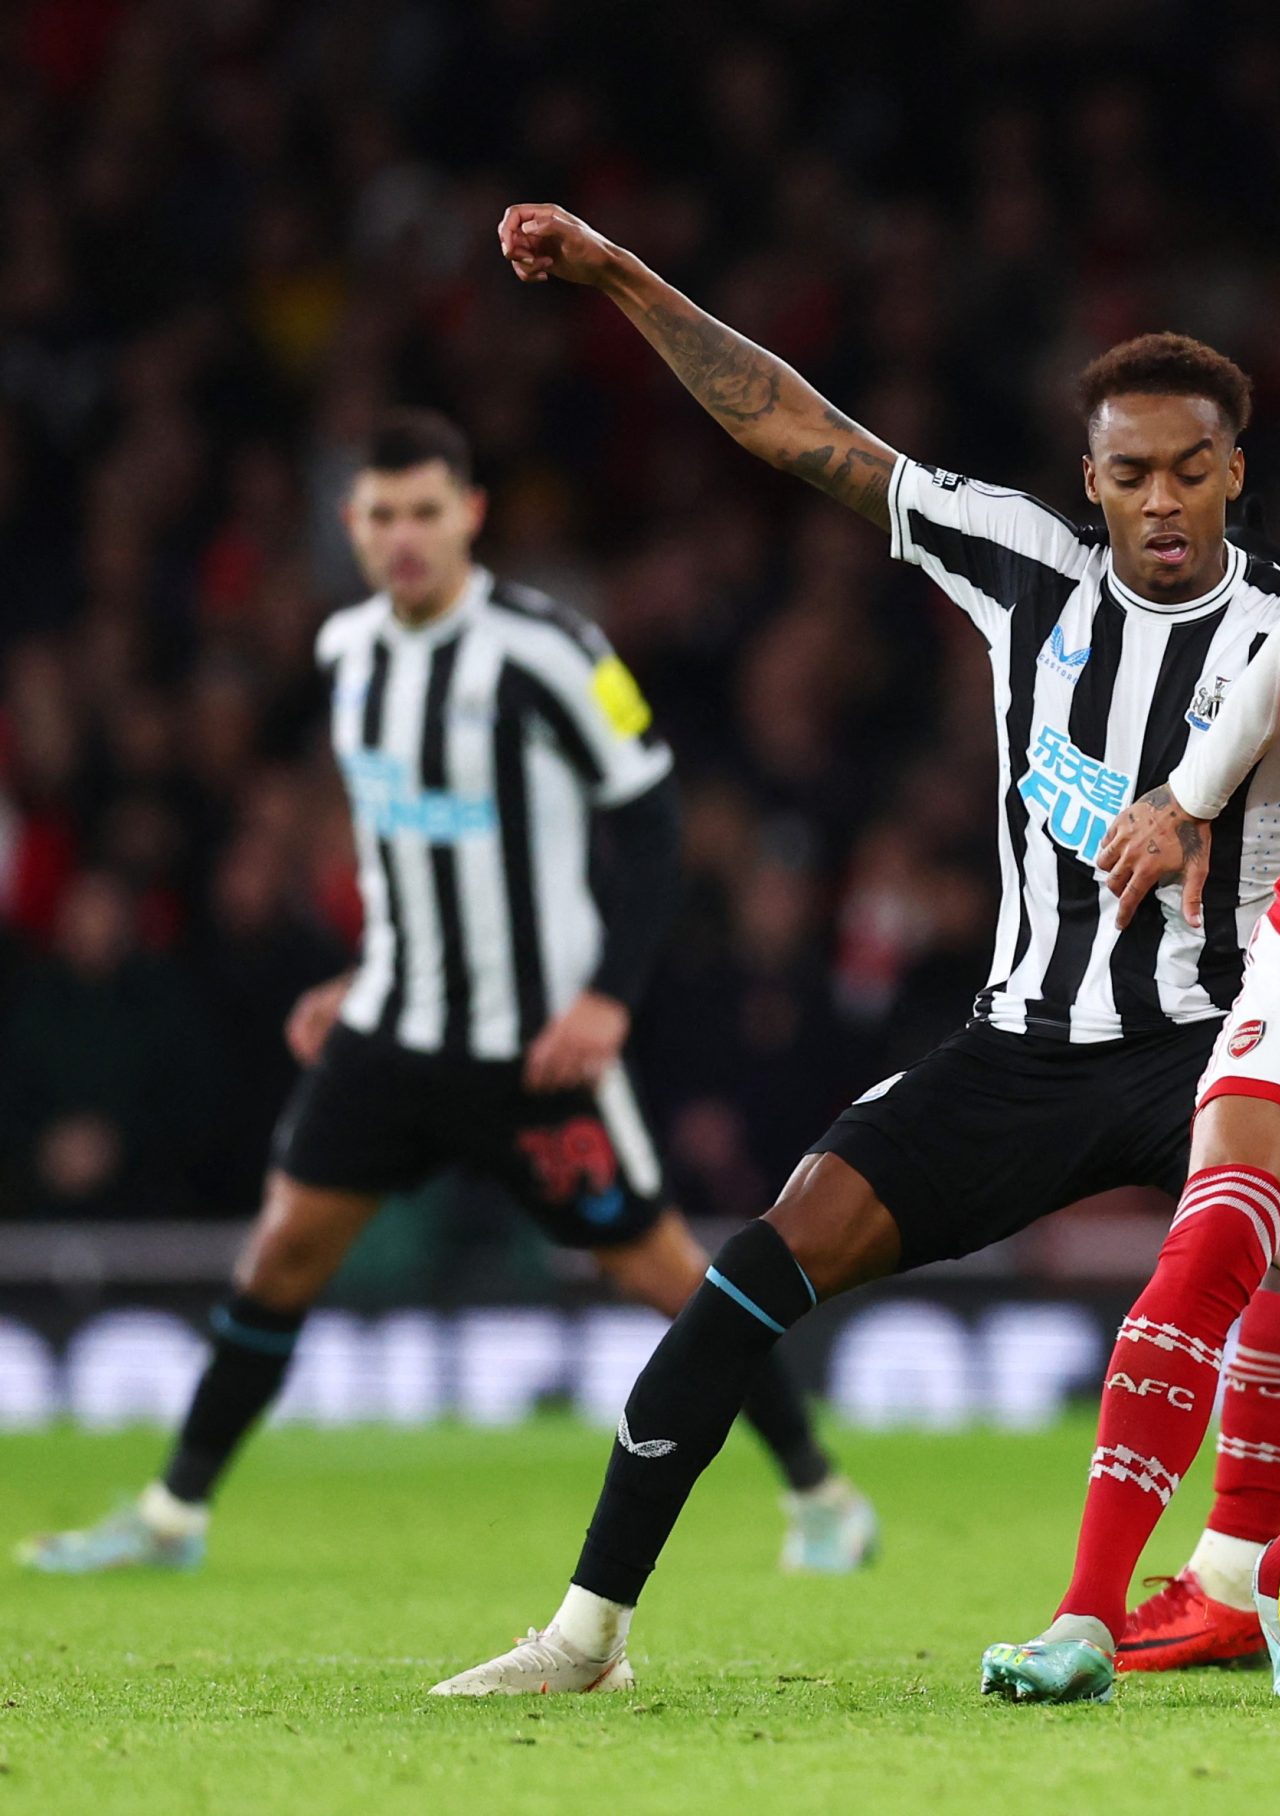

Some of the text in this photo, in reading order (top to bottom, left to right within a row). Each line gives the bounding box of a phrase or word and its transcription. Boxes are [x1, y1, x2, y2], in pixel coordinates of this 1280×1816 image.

[1033, 726, 1130, 815] 乐天堂
[1105, 1372, 1195, 1411] AFC
